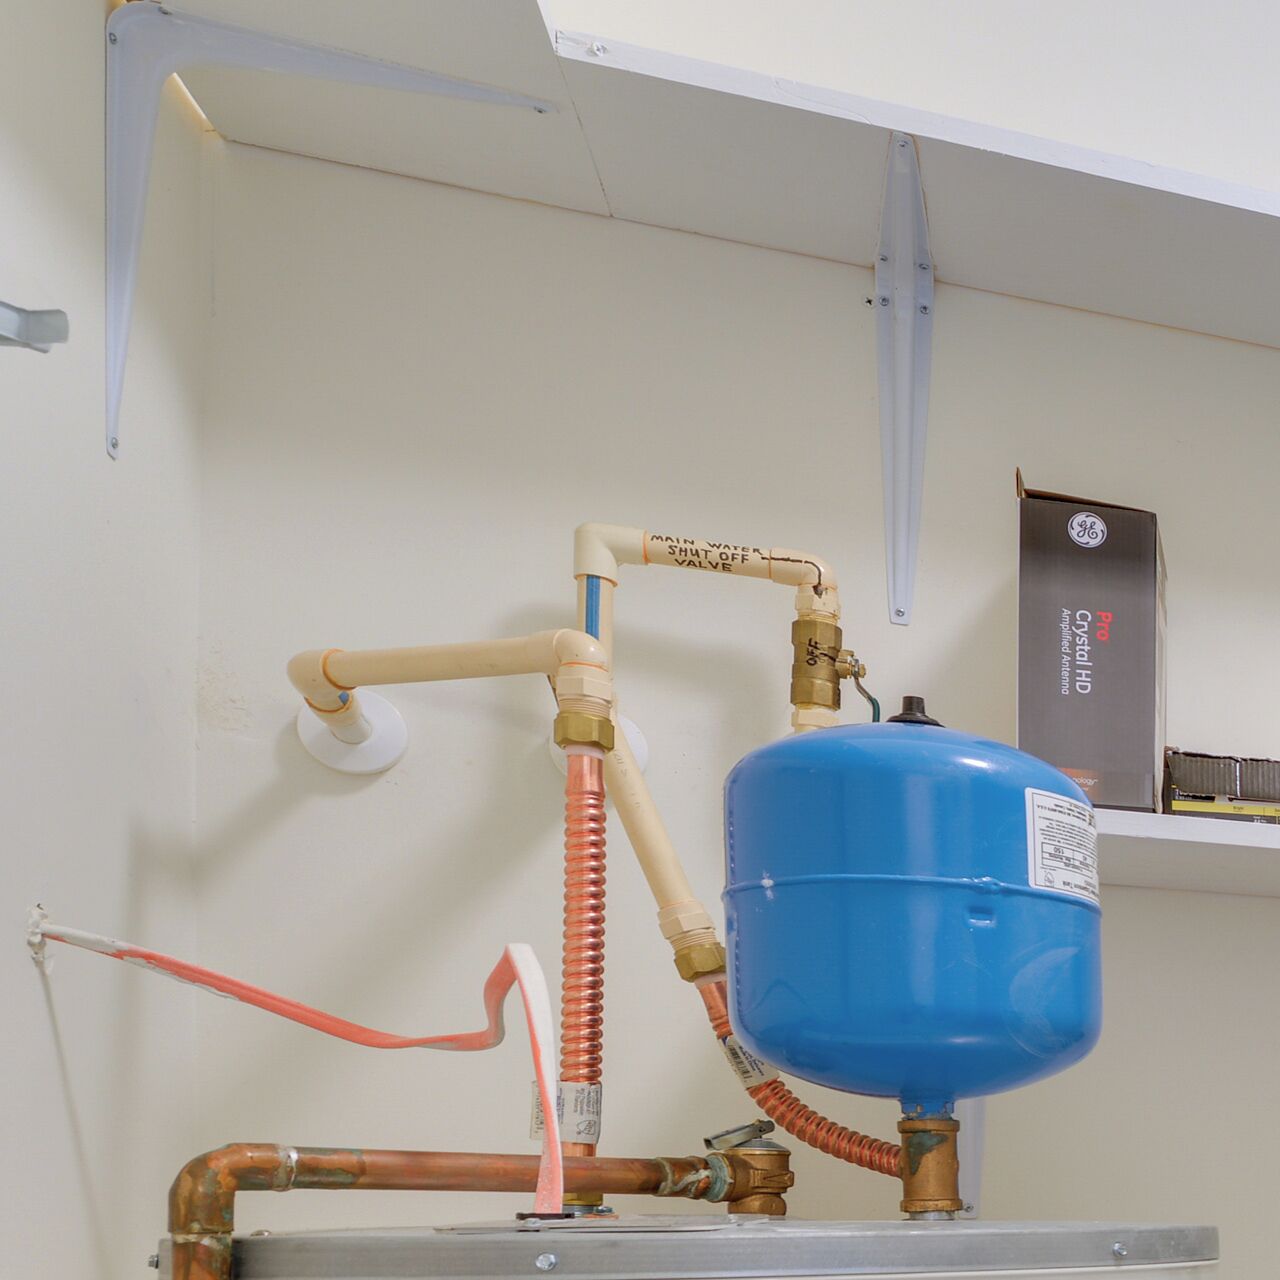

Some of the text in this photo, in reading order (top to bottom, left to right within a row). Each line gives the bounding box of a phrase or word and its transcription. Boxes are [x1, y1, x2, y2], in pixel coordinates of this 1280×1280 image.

[650, 534, 763, 556] MAIN WATER
[668, 545, 749, 564] SHUT OFF
[674, 558, 732, 572] VALVE
[1096, 611, 1113, 641] Pro
[1060, 607, 1073, 695] Amplified Antenna
[1072, 609, 1093, 695] Crystal HD
